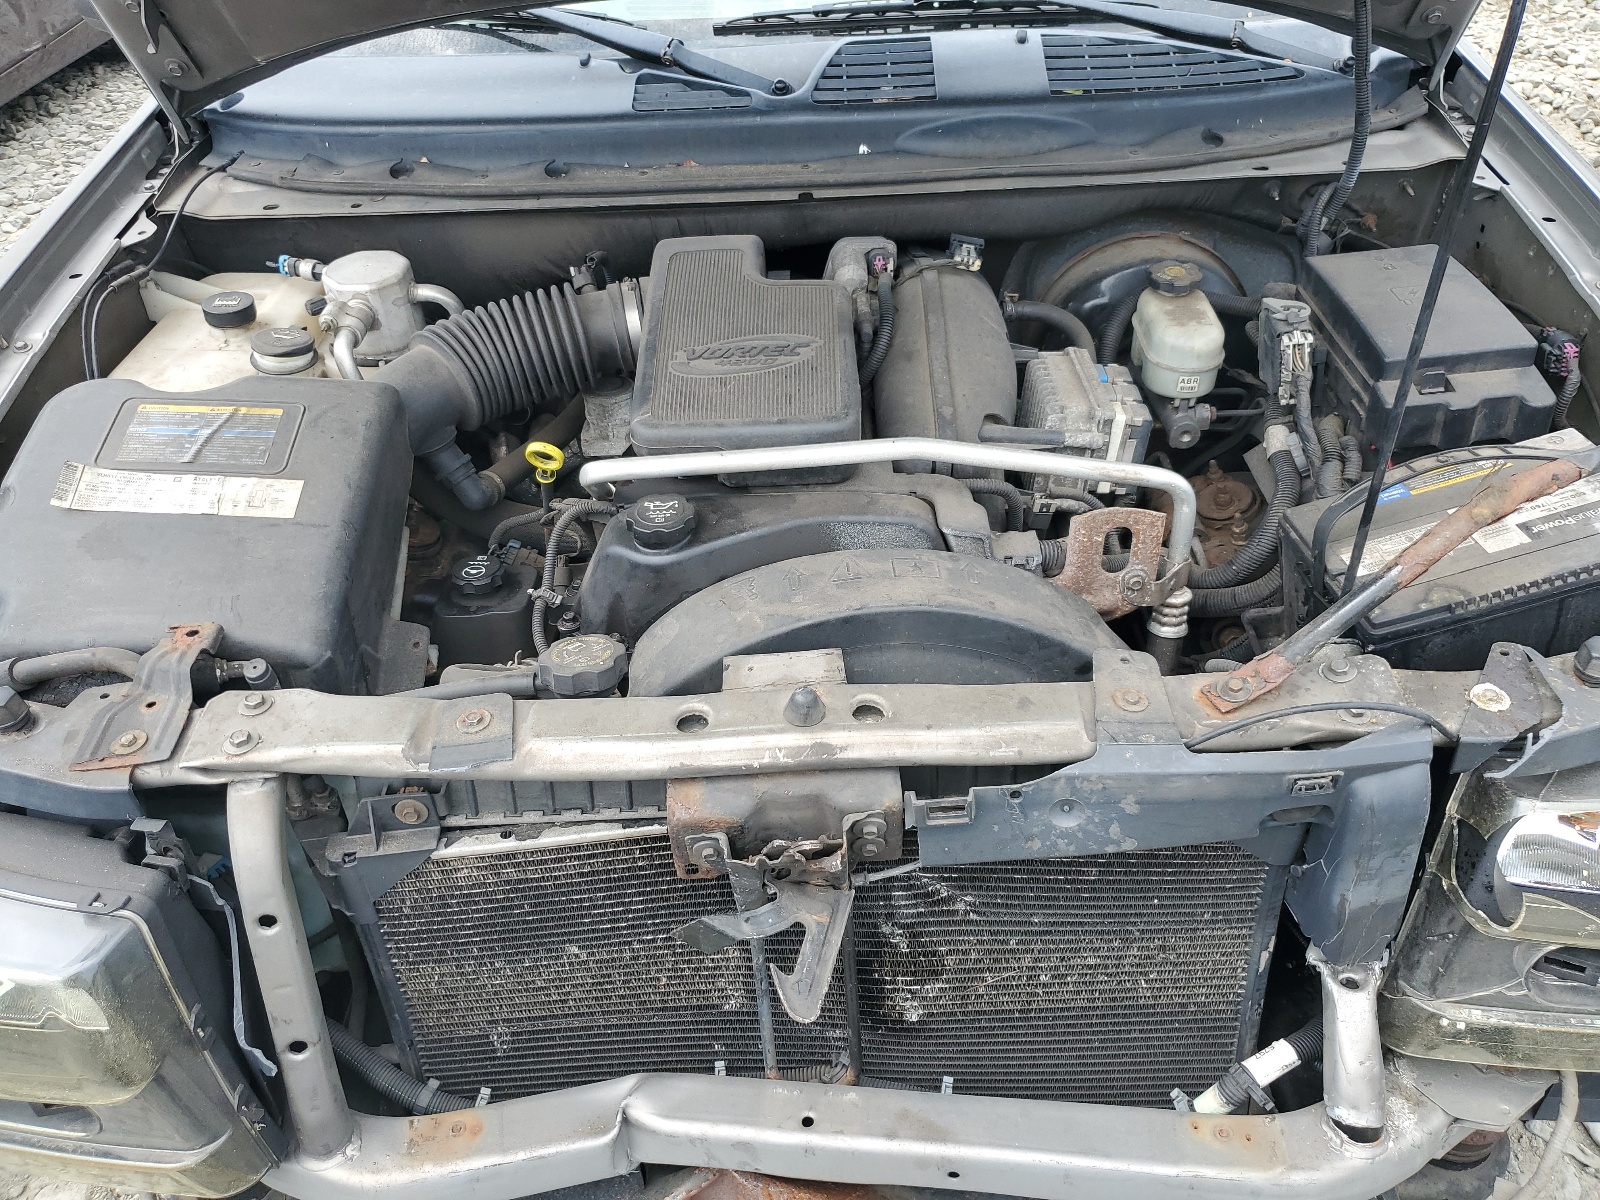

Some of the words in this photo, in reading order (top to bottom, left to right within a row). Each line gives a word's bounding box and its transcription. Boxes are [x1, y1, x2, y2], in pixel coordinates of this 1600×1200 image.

[686, 342, 811, 361] VORTEC
[714, 357, 779, 367] 4200
[1531, 507, 1600, 534] aluePower
